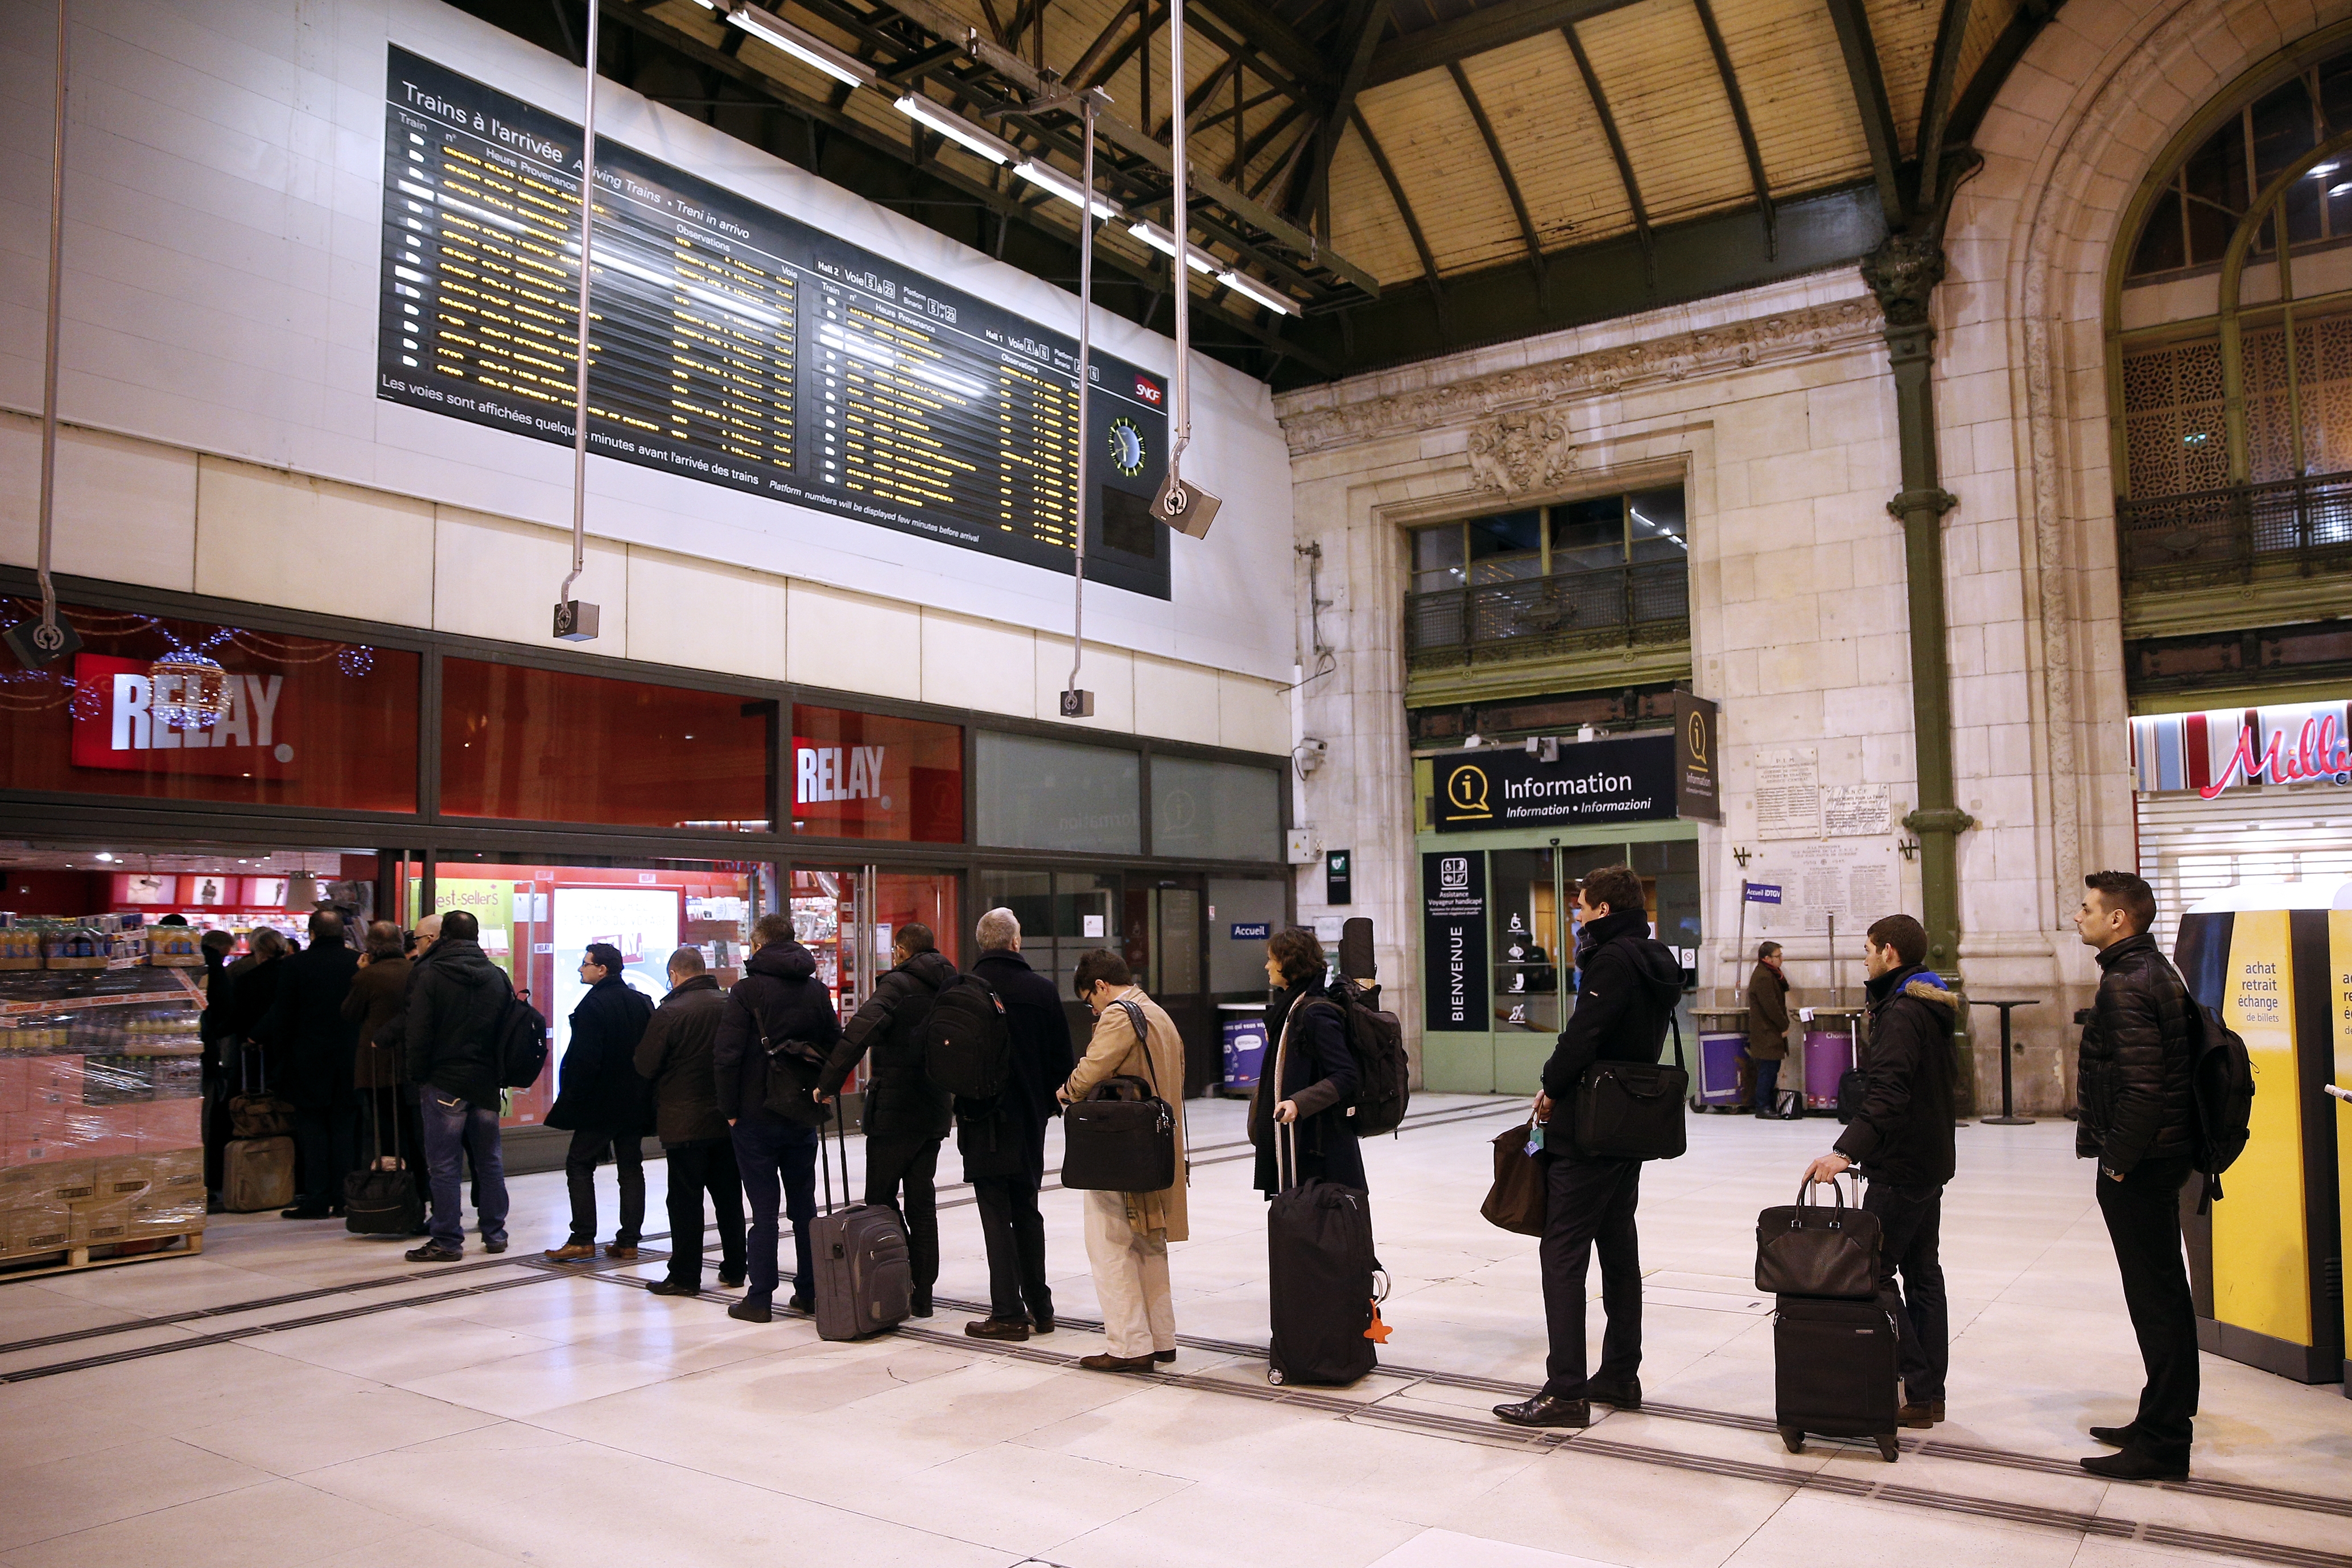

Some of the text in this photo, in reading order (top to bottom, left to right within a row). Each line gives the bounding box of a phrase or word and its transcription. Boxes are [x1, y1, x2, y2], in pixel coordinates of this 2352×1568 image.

[402, 80, 563, 163] Trains à l'arrivée
[572, 159, 661, 203] Aiving Trains
[399, 112, 427, 131] Train
[486, 147, 517, 168] Heure
[521, 162, 577, 191] Provenance
[676, 224, 731, 252] Observations
[781, 266, 798, 279] Voie
[676, 200, 749, 239] Treni in arrivo
[818, 261, 833, 274] Hall
[844, 270, 864, 286] Voie
[903, 286, 926, 301] Platform
[822, 282, 840, 296] Train
[876, 303, 896, 317] Heure
[898, 312, 935, 333] Provenance
[1008, 337, 1024, 350] Voie
[1001, 352, 1080, 390] Observations Voi
[1136, 384, 1161, 401] SNCF
[382, 373, 406, 392] Les
[408, 382, 443, 402] voies
[446, 393, 476, 410] sont
[478, 401, 532, 426] affichées
[591, 432, 635, 452] minutes
[638, 445, 668, 461] avant
[671, 451, 709, 472] l'arrivée
[711, 463, 729, 477] des
[732, 470, 760, 485] trains
[769, 480, 802, 496] Platform
[804, 492, 837, 507] numbers
[839, 500, 852, 510] will
[853, 503, 863, 513] be
[864, 505, 896, 523] displayed
[898, 514, 910, 524] few
[911, 519, 938, 532] minutes
[939, 526, 959, 538] before
[1504, 771, 1632, 799] Information
[1507, 798, 1651, 818] Information Informazioni
[1234, 925, 1265, 936] Accueil
[1451, 926, 1464, 1021] BIENVENUE
[2246, 960, 2276, 975] achat
[2242, 979, 2277, 991] retrait
[2238, 994, 2278, 1011] échange
[2247, 1013, 2279, 1023] de billets
